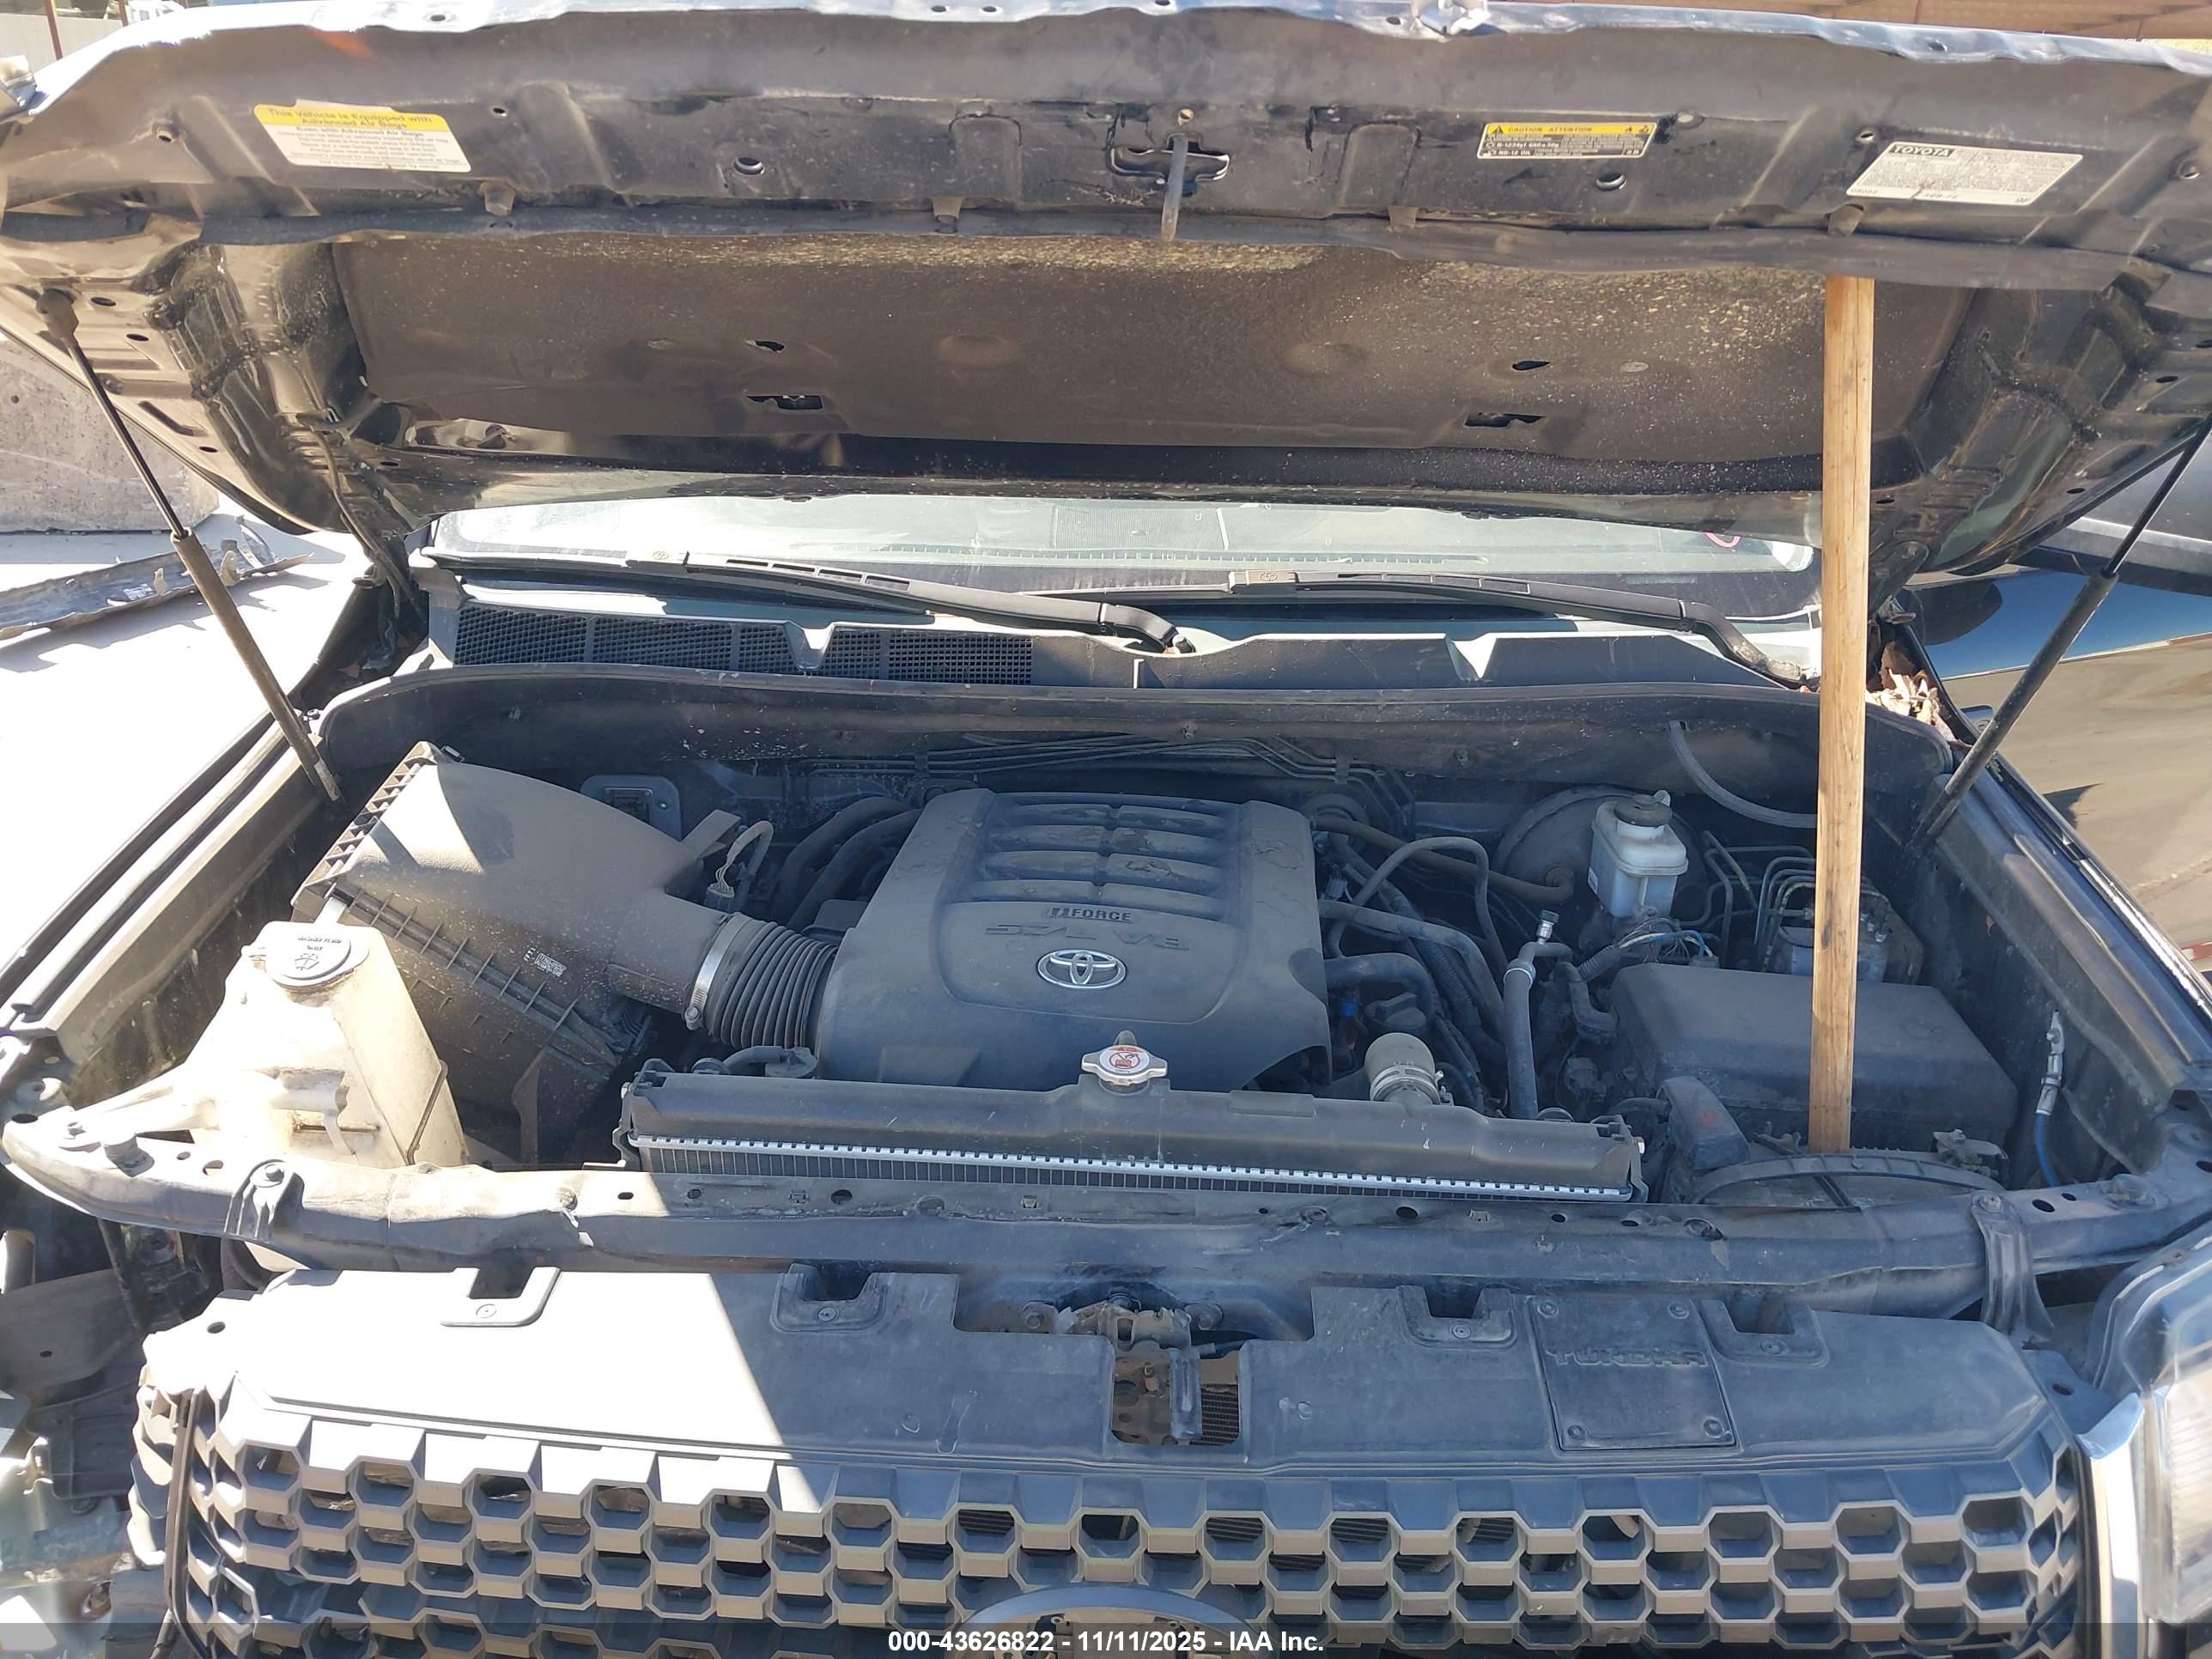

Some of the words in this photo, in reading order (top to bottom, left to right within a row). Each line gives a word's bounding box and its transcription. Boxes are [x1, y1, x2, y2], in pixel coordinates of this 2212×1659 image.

[268, 108, 293, 118] This
[295, 110, 337, 119] Vehicle
[339, 112, 349, 120] is
[352, 112, 405, 124] Equipped
[409, 115, 432, 124] with
[301, 118, 356, 127] Advanced
[379, 121, 408, 130] Bags
[1893, 145, 1954, 157] TOYOTA
[1546, 1348, 1709, 1367] TUNDRA
